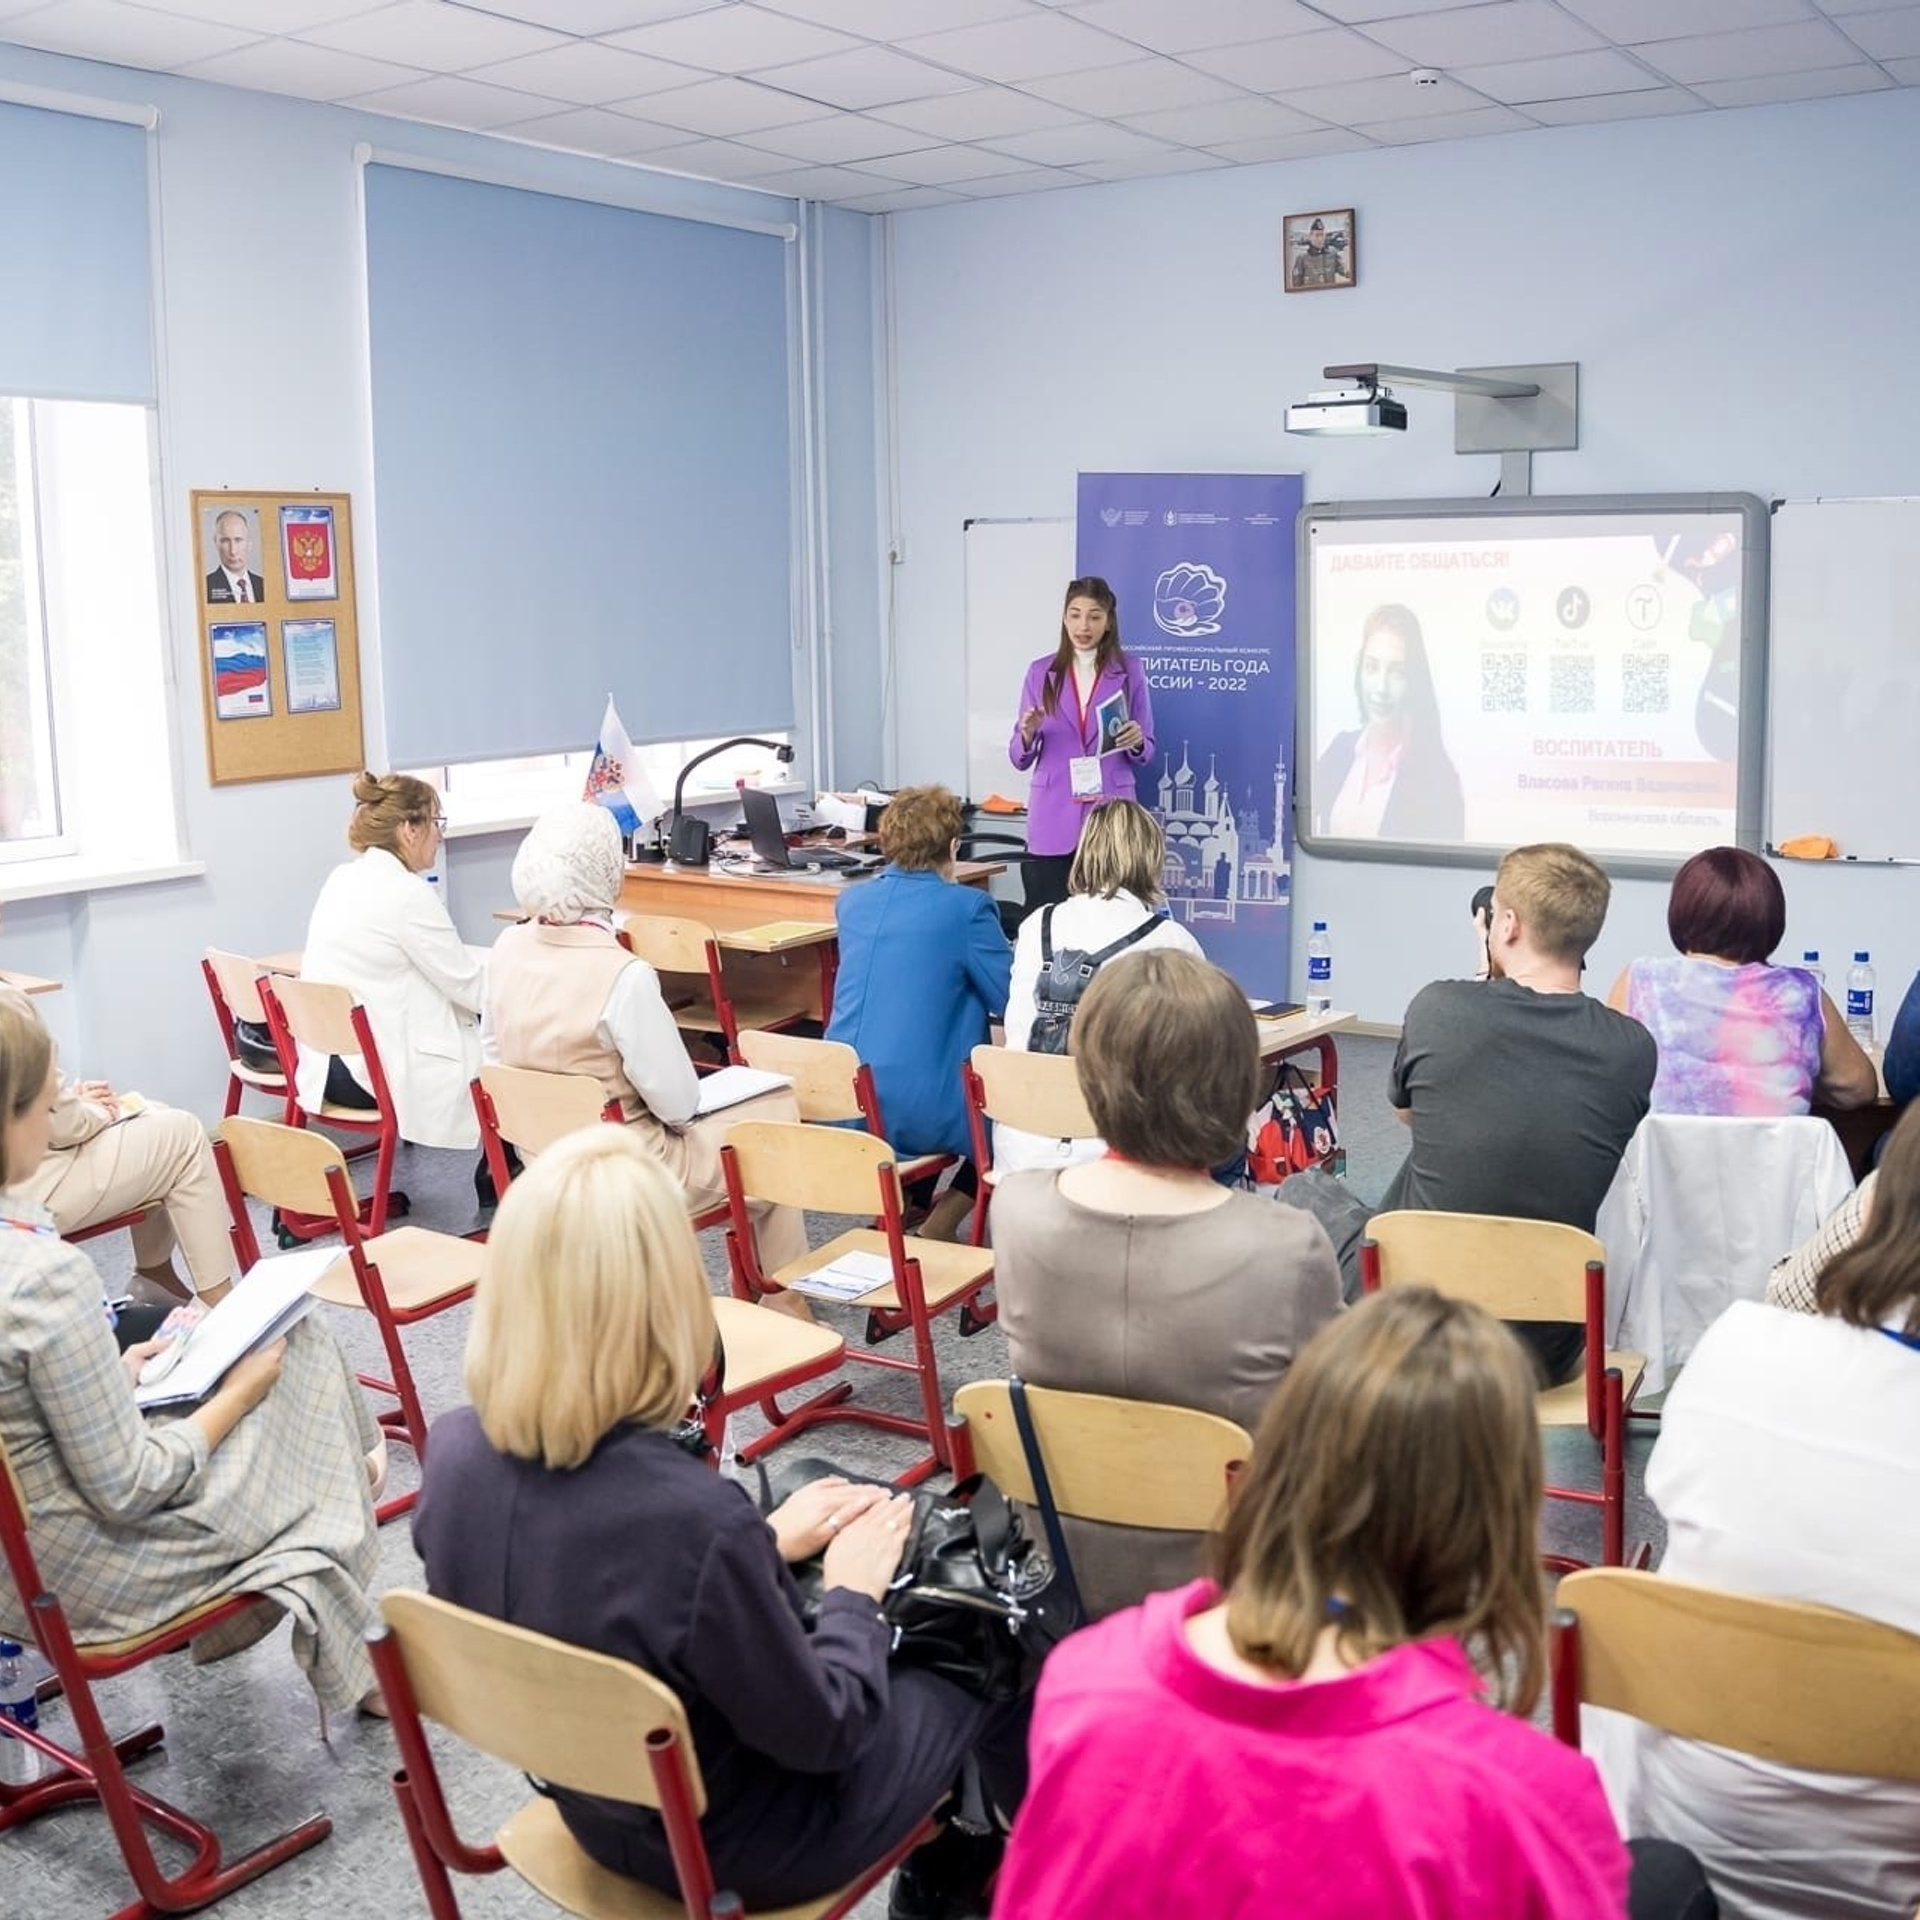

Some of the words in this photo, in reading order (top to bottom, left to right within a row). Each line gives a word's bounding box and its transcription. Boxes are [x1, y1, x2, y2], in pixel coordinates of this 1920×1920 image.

[1331, 551, 1405, 573] ДАВАЙТЕ
[1140, 657, 1222, 672] ПИТАТЕЛЬ
[1225, 659, 1270, 675] ГОДА
[1146, 675, 1193, 690] ССИИ
[1208, 677, 1247, 691] 2022
[1533, 740, 1663, 758] ВОСПИТАТЕЛЬ
